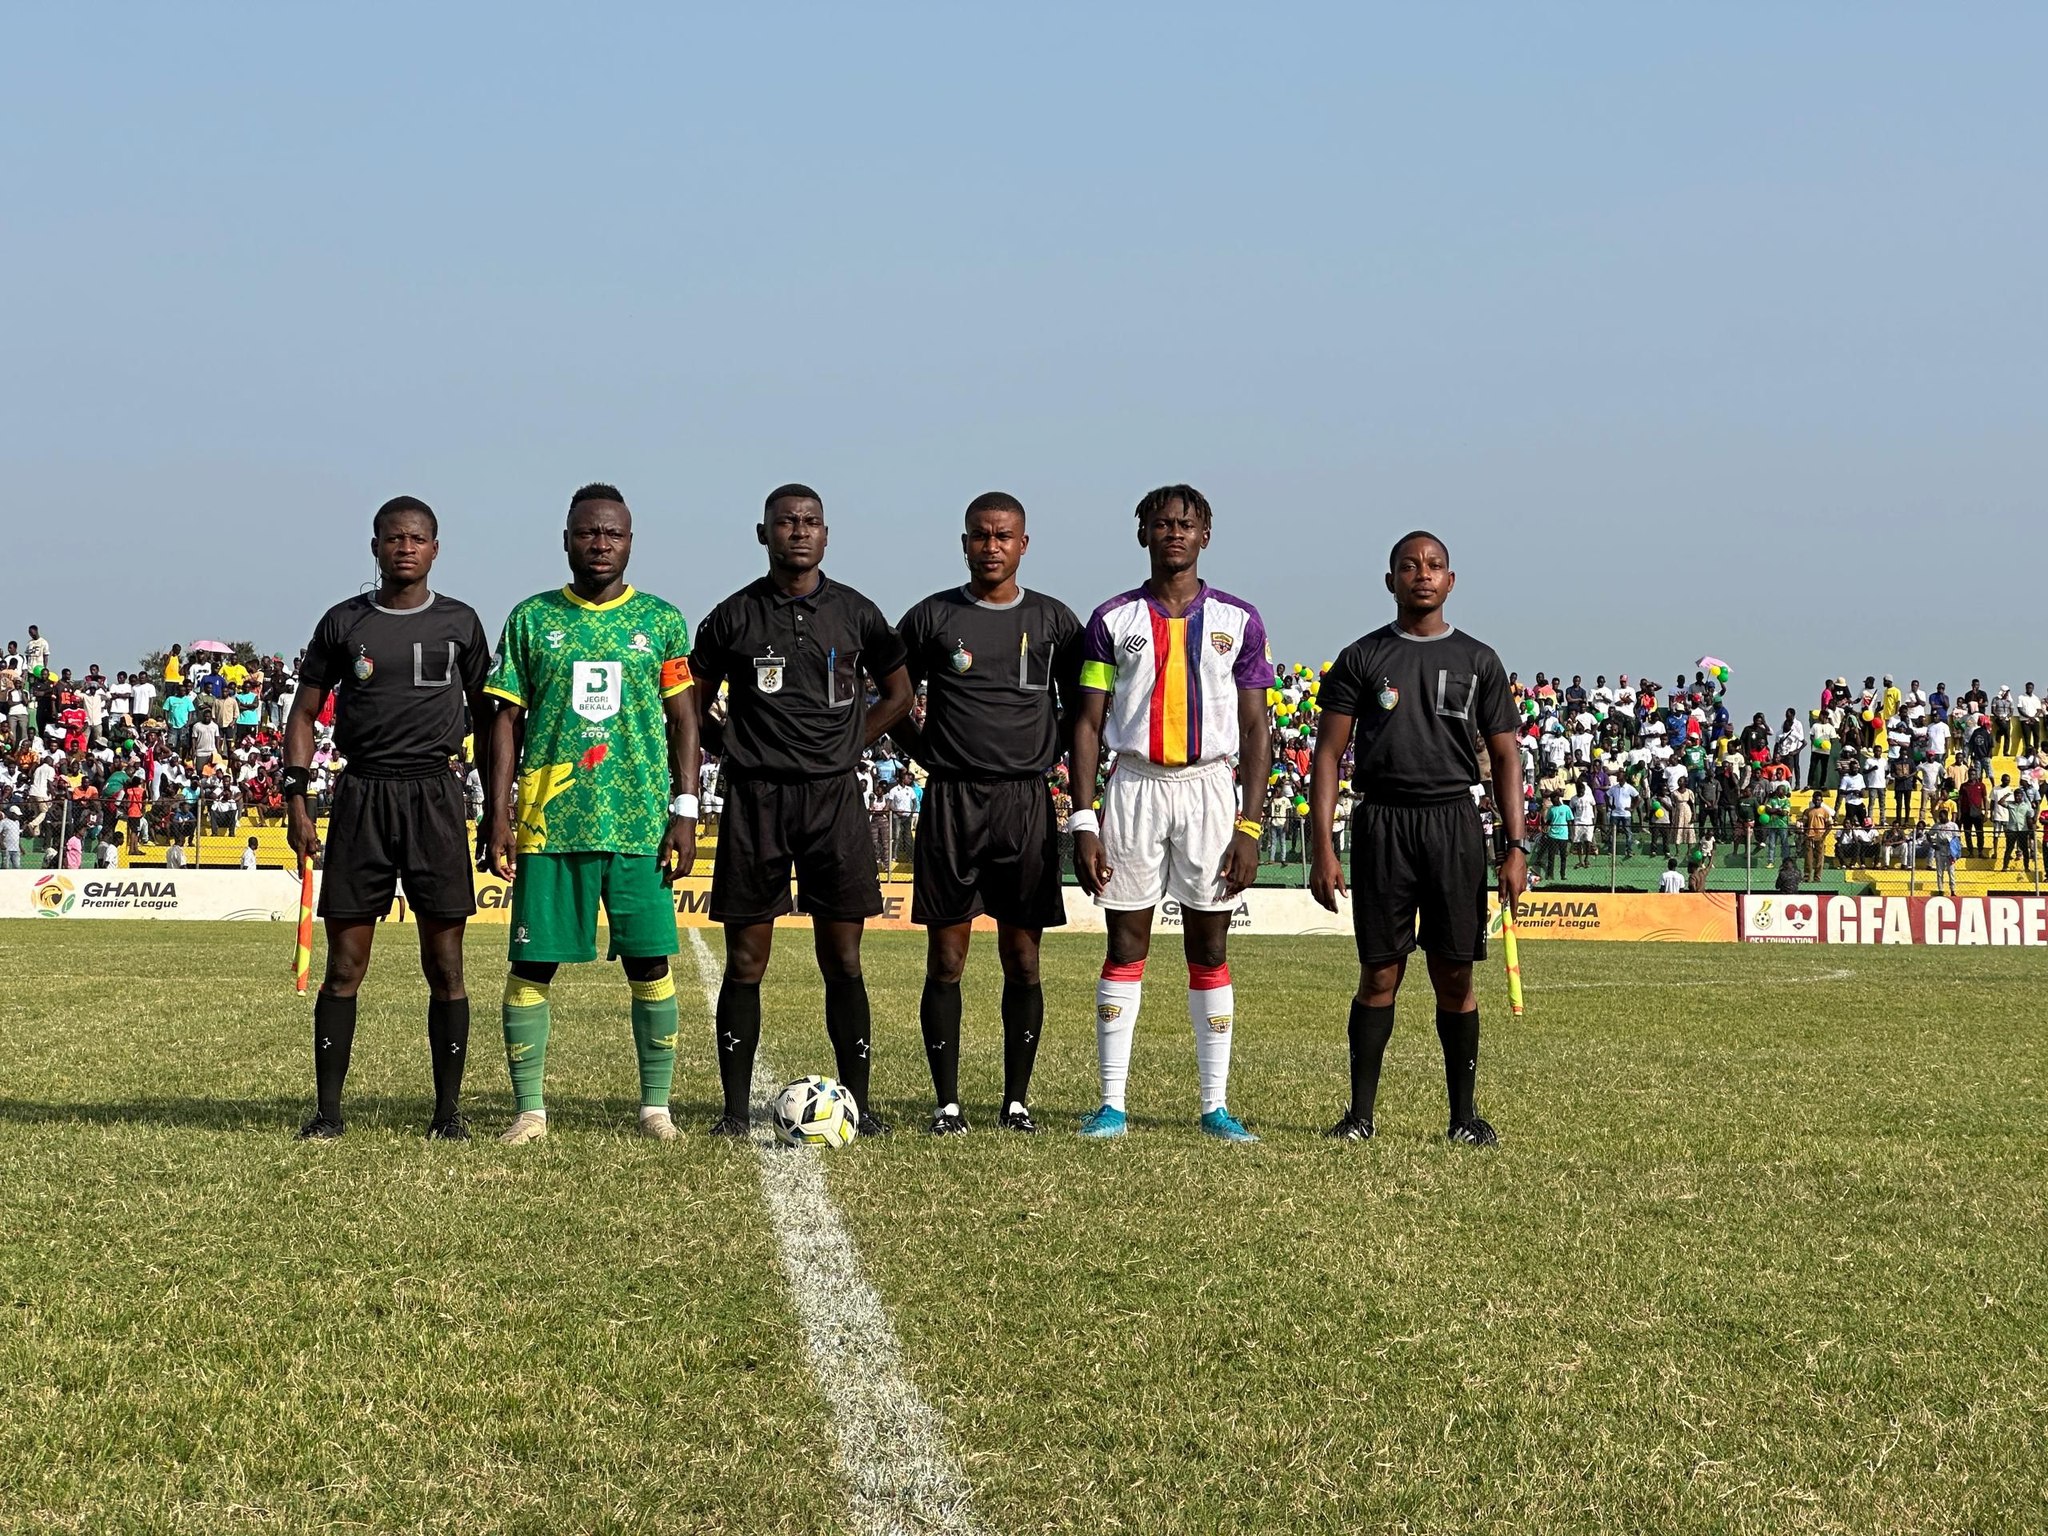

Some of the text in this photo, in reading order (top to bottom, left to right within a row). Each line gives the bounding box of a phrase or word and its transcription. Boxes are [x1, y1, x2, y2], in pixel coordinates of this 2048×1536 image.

[84, 882, 176, 897] GHANA
[81, 899, 178, 910] Premier League
[1517, 902, 1599, 917] GHANA
[1559, 919, 1600, 929] League
[1827, 895, 2048, 946] GFA CARE
